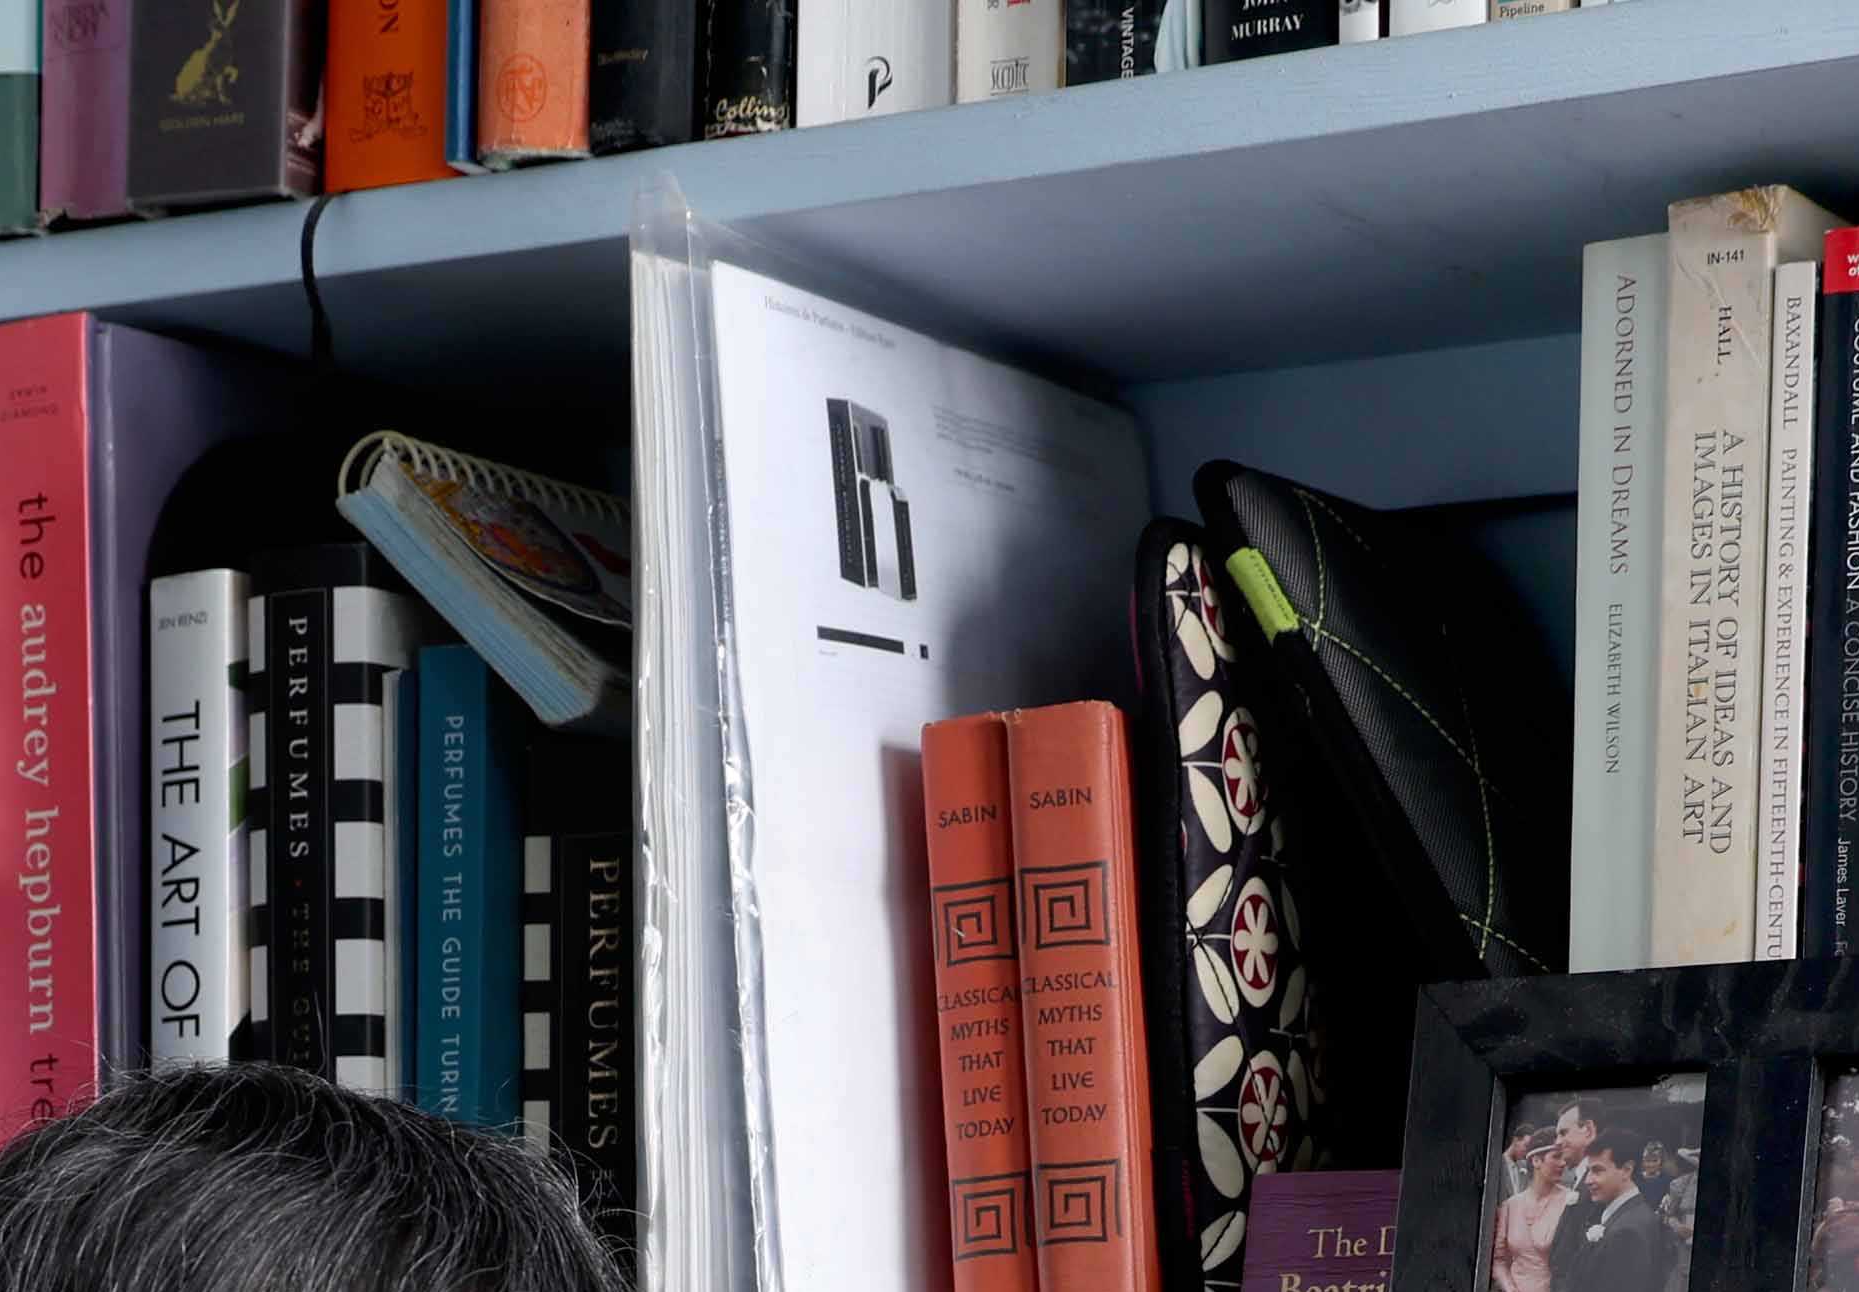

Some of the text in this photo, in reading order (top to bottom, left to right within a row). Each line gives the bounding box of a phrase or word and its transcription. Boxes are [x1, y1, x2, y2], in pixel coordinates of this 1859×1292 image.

[1230, 12, 1306, 40] MURRAY
[1706, 248, 1745, 265] IN-141
[1716, 305, 1733, 365] HALL
[1604, 272, 1637, 775] ADORNED IN DREAMS ELIZABETH WILSON
[1681, 431, 1718, 844] IMAGES IN ITALIAN ART
[1711, 431, 1745, 856] A HISTORY OF IDEAS AND
[17, 494, 59, 1034] the audrey hepburn
[442, 714, 464, 858] PERFUMES
[1838, 730, 1859, 824] HISTORY
[1030, 787, 1092, 810] SABIN
[161, 702, 200, 1039] THE ART OF
[442, 873, 462, 922] THE
[1834, 837, 1851, 928] James Laver
[442, 937, 461, 1019] GUIDE
[1021, 970, 1118, 996] CLASSICAL
[1039, 1005, 1102, 1025] MYTHS
[1047, 1037, 1096, 1057] THAT
[1052, 1071, 1095, 1091] LIVE
[1042, 1103, 1107, 1126] TODAY
